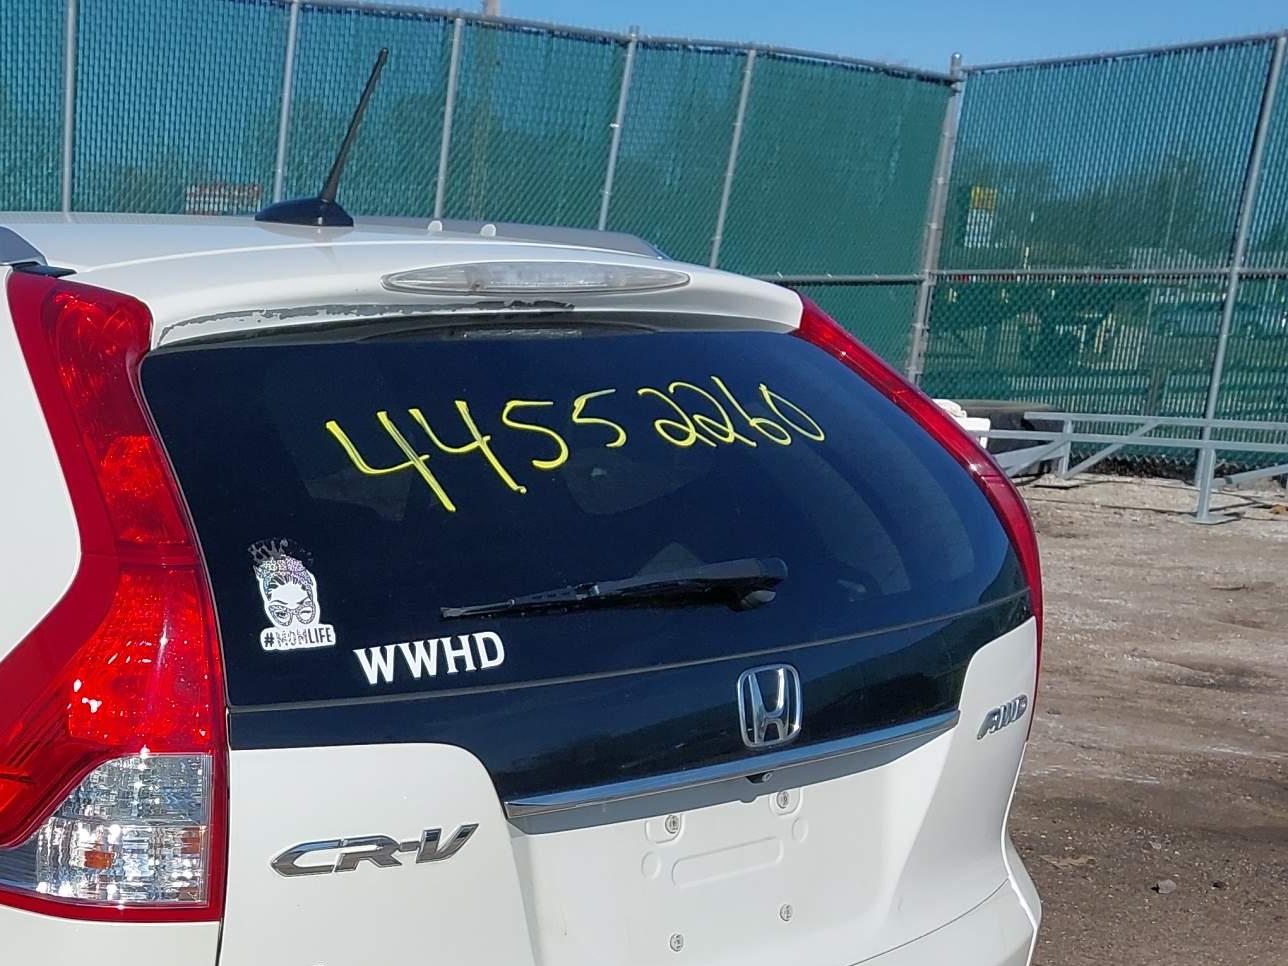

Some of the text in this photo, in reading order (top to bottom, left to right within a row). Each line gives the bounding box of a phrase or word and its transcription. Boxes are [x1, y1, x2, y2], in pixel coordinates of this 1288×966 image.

[325, 376, 825, 512] 44552260
[263, 627, 334, 648] #MOMLIFE
[353, 631, 505, 685] WWHD
[270, 823, 479, 877] CR-V
